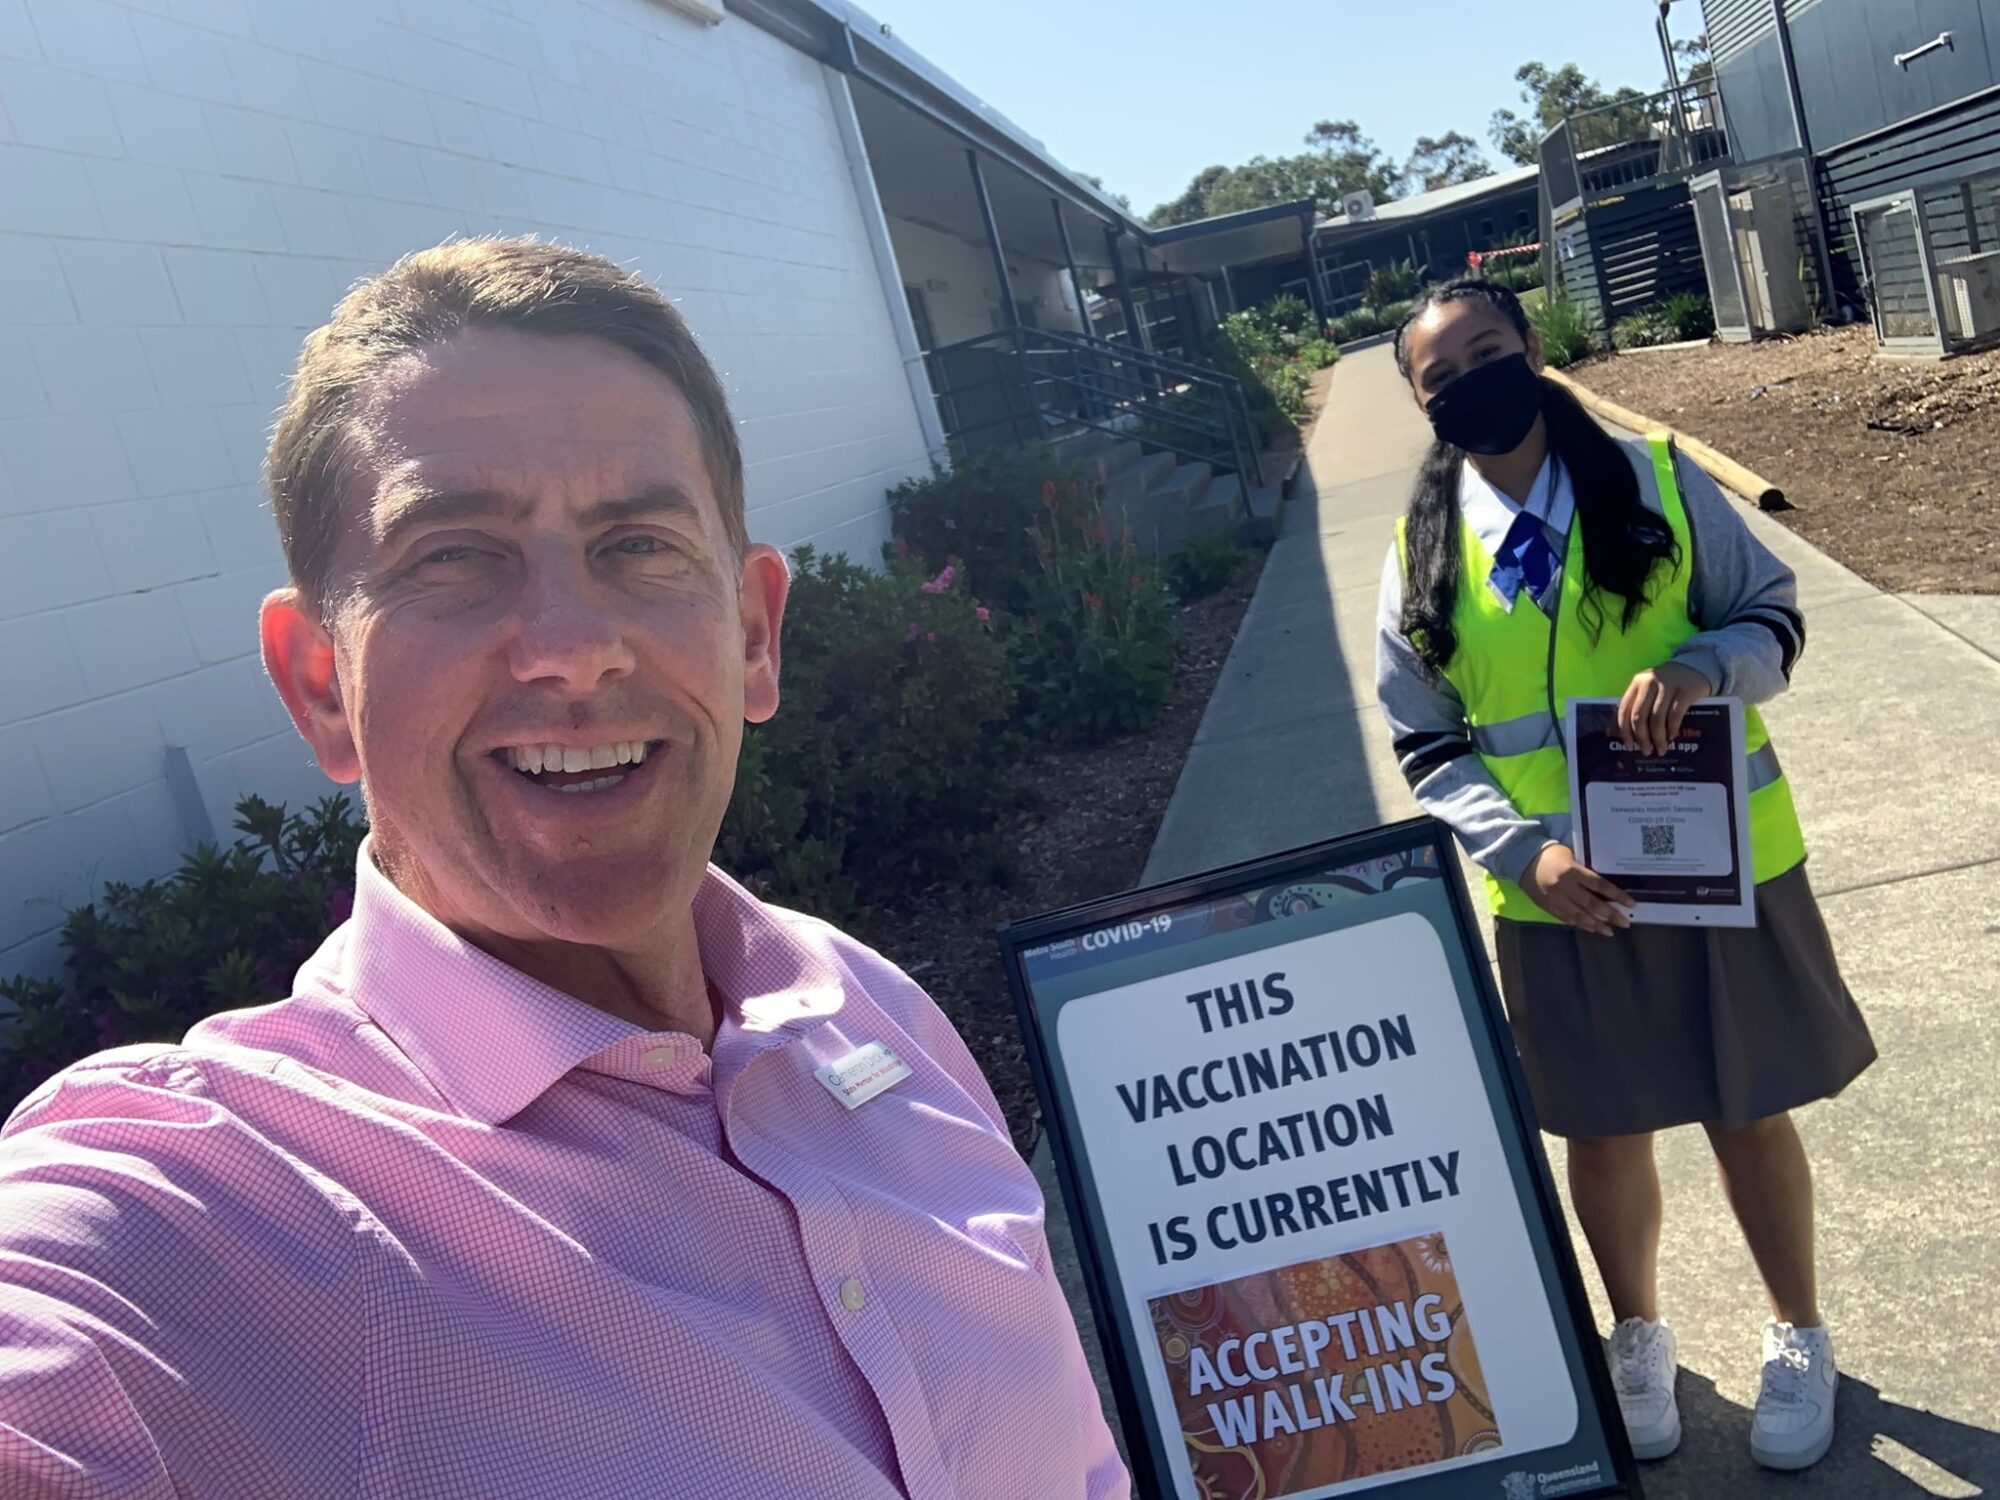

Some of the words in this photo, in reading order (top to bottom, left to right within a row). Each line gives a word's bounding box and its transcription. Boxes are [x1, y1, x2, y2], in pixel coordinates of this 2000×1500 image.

[1678, 742, 1699, 753] app
[1050, 938, 1076, 952] South
[1082, 914, 1172, 950] COVID-19
[1186, 972, 1294, 1033] THIS
[1115, 1014, 1417, 1123] VACCINATION
[1167, 1093, 1394, 1186] LOCATION
[1148, 1216, 1197, 1265] IS
[1206, 1150, 1460, 1250] CURRENTLY
[1189, 1293, 1452, 1397] ACCEPTING
[1206, 1352, 1456, 1449] WALK-INS
[1537, 1460, 1599, 1484] Queensland
[1540, 1474, 1602, 1495] Government
